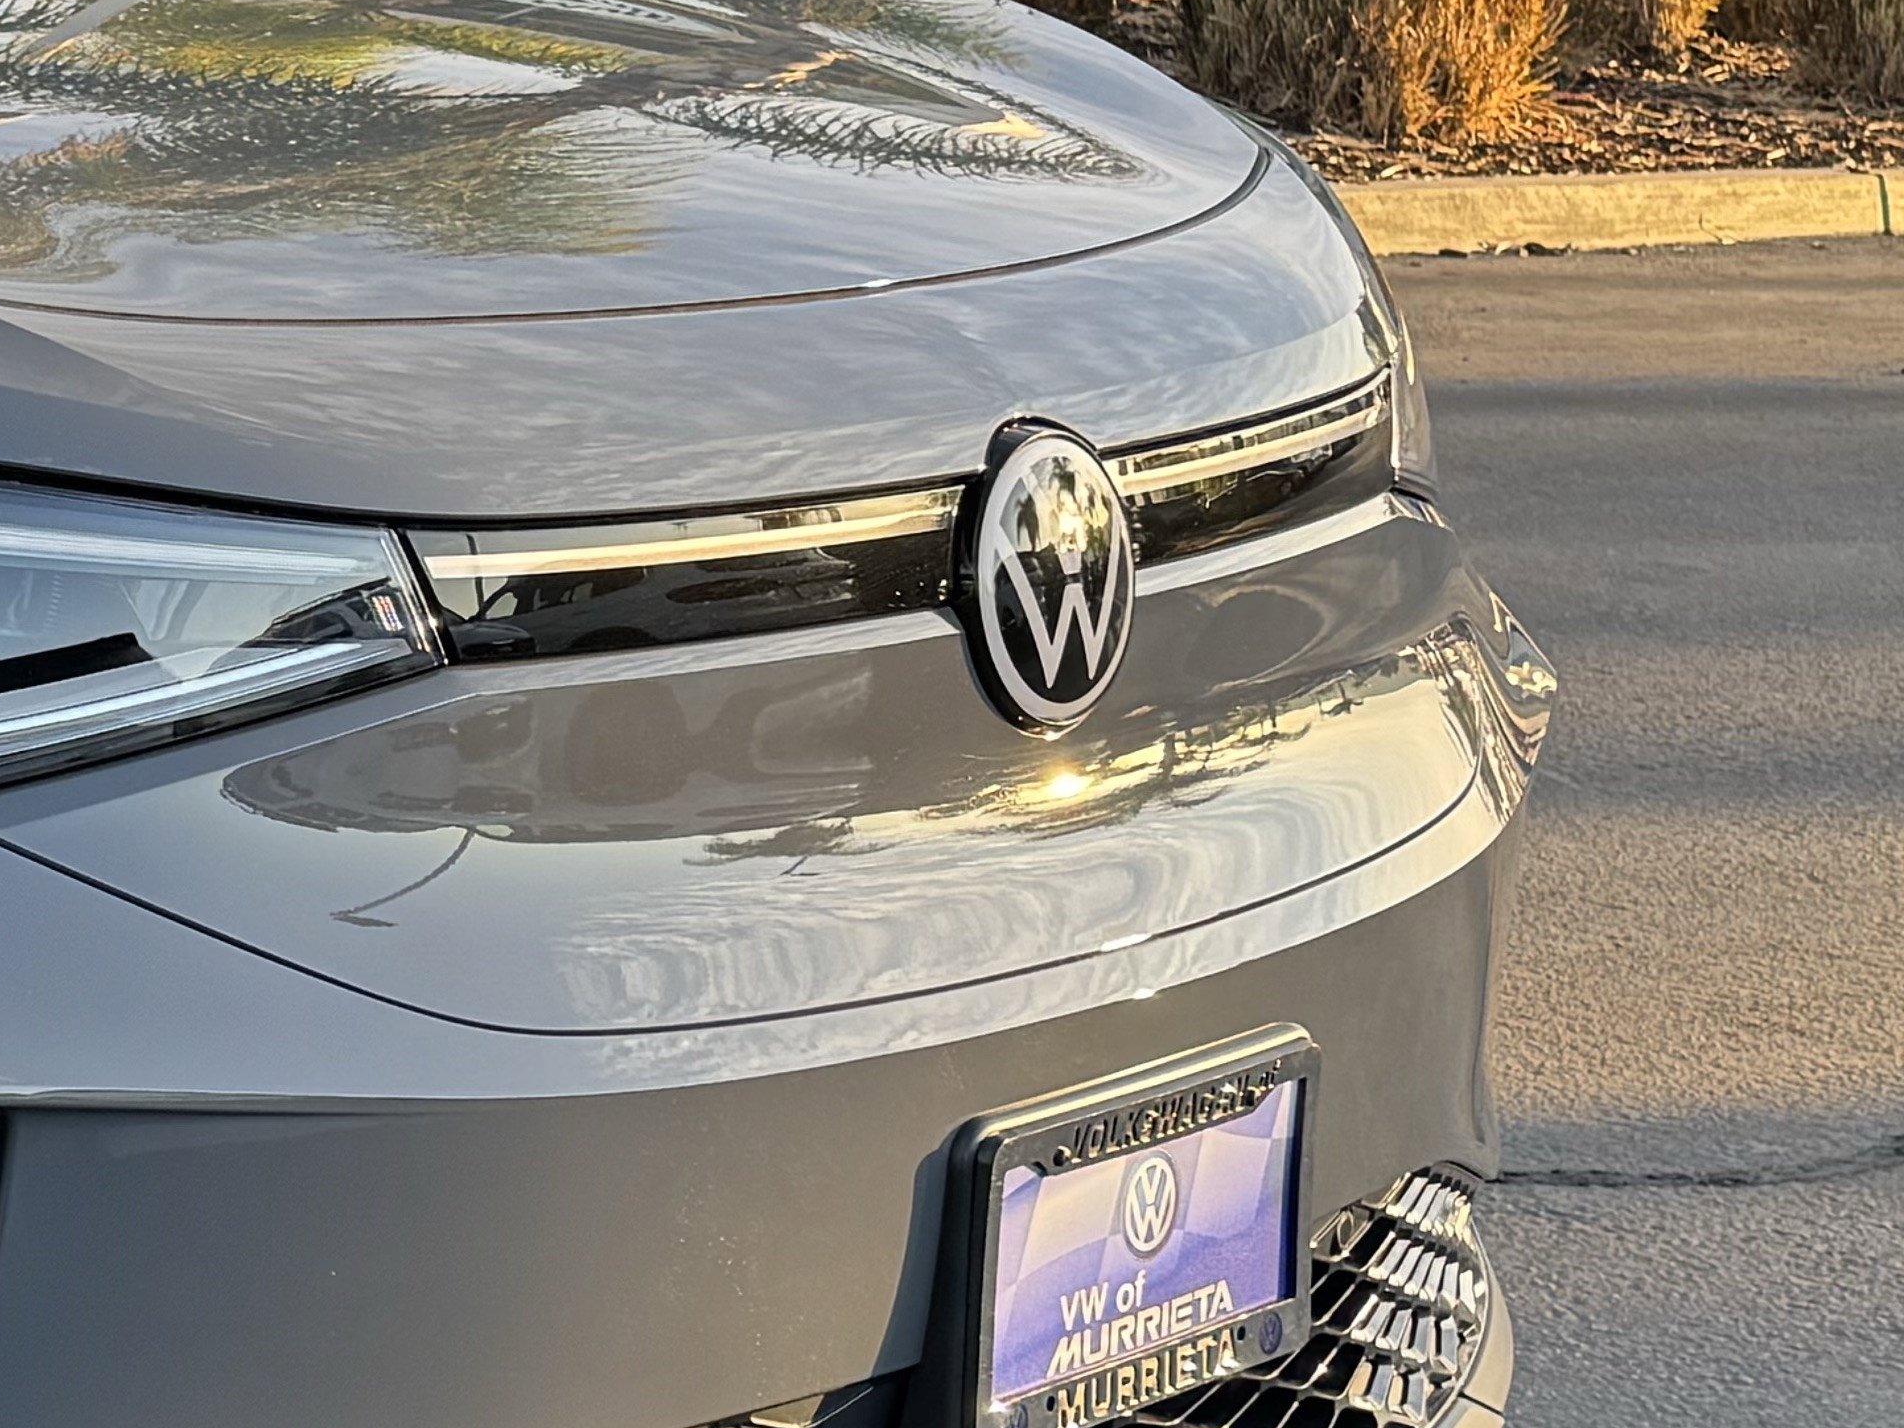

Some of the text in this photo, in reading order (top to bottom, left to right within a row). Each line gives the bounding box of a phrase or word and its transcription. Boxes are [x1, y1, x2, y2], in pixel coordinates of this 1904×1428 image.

[978, 429, 1135, 724] VW
[1123, 1155, 1177, 1252] VW
[1046, 1280, 1234, 1381] MURRIETA
[1059, 1269, 1146, 1331] VW of
